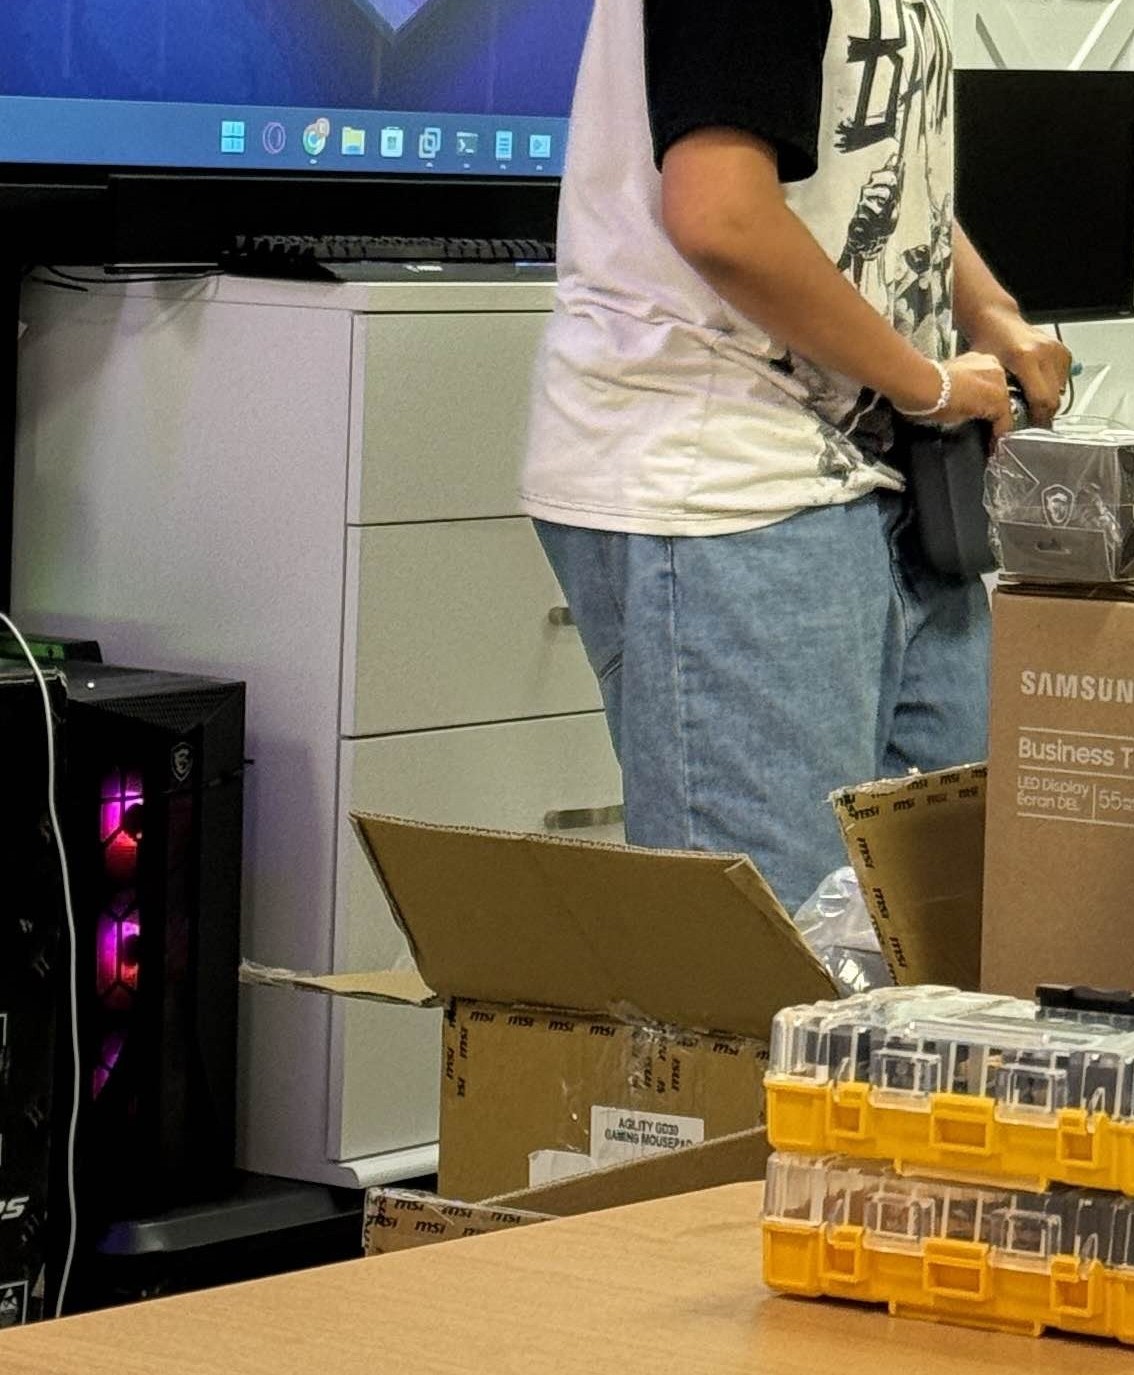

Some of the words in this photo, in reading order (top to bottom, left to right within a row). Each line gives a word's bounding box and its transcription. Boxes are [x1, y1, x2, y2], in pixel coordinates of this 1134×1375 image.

[1018, 736, 1115, 767] Business
[1017, 775, 1040, 790] LED
[1042, 778, 1089, 798] Display
[1098, 790, 1123, 811] 55
[470, 1010, 496, 1023] msi
[507, 1015, 535, 1028] msi
[548, 1020, 575, 1033] msi
[589, 1025, 617, 1037] msi
[394, 1199, 425, 1212] msi
[414, 1221, 447, 1235] msi
